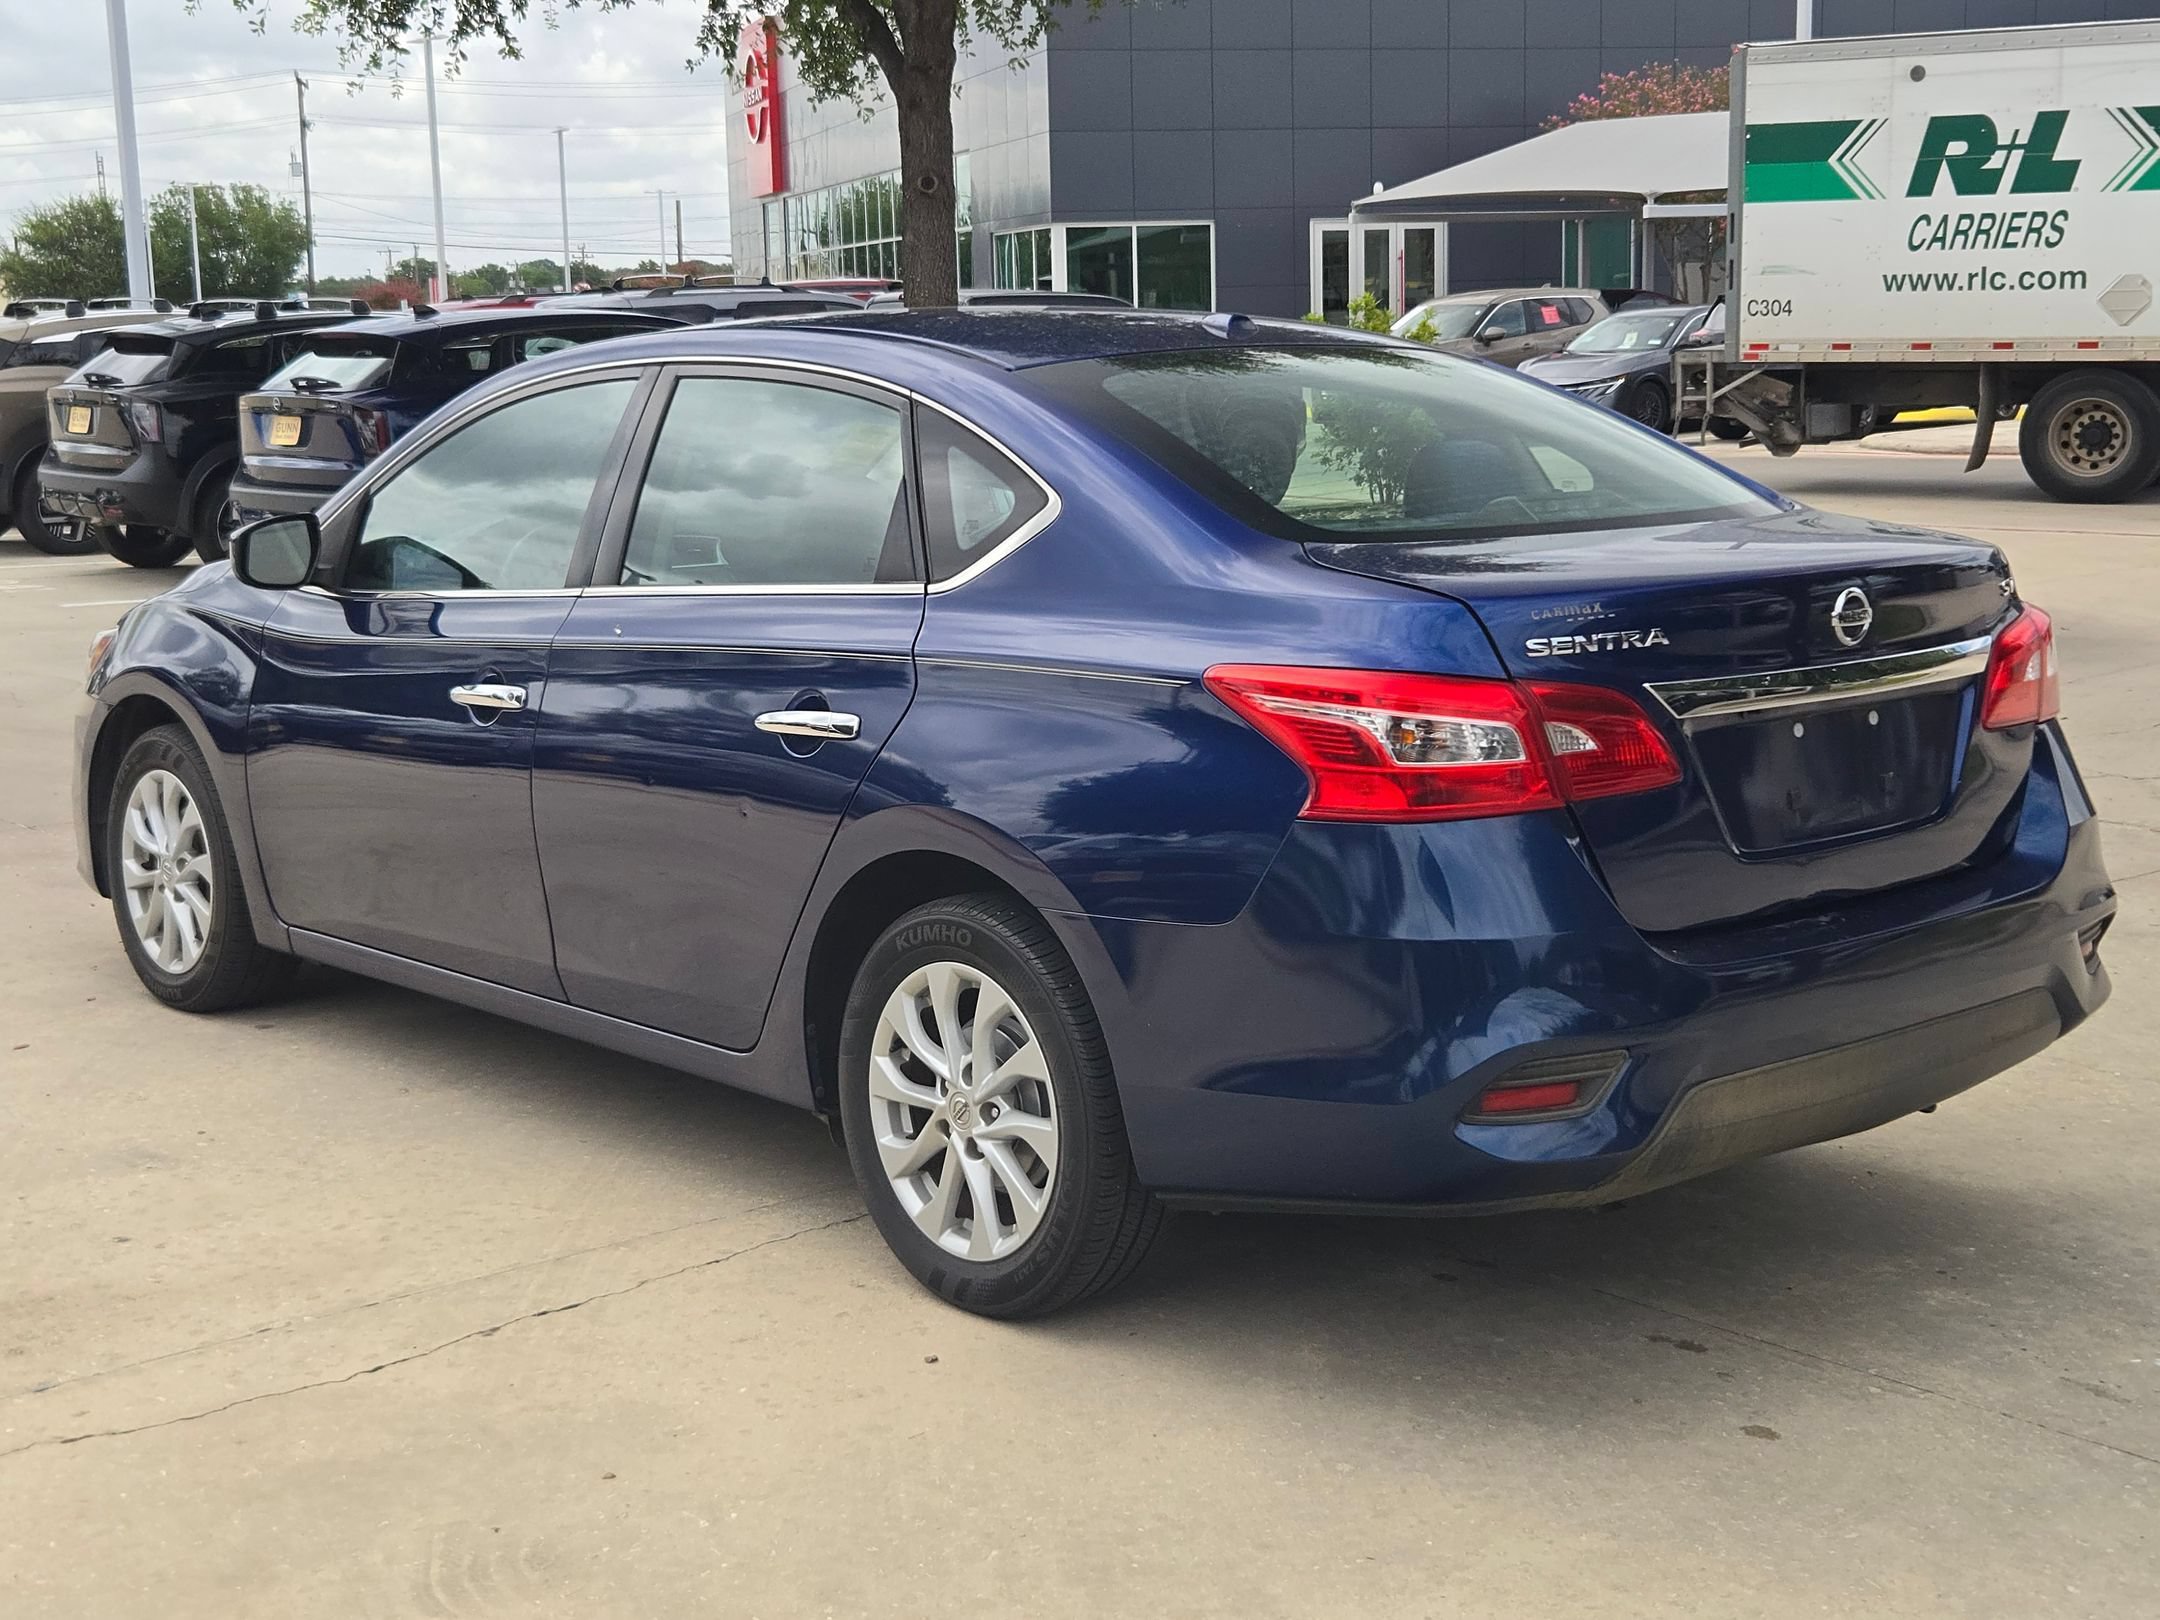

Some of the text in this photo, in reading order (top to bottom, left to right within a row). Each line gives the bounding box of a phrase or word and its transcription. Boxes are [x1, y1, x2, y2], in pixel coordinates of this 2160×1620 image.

[1904, 109, 2082, 198] R+L
[1907, 209, 2069, 252] CARRIERS
[1881, 266, 2088, 292] www.rlc.com
[1747, 299, 1792, 317] C304
[275, 421, 300, 433] GUNN
[1525, 627, 1671, 658] SENTRA
[895, 924, 973, 952] KUMHO
